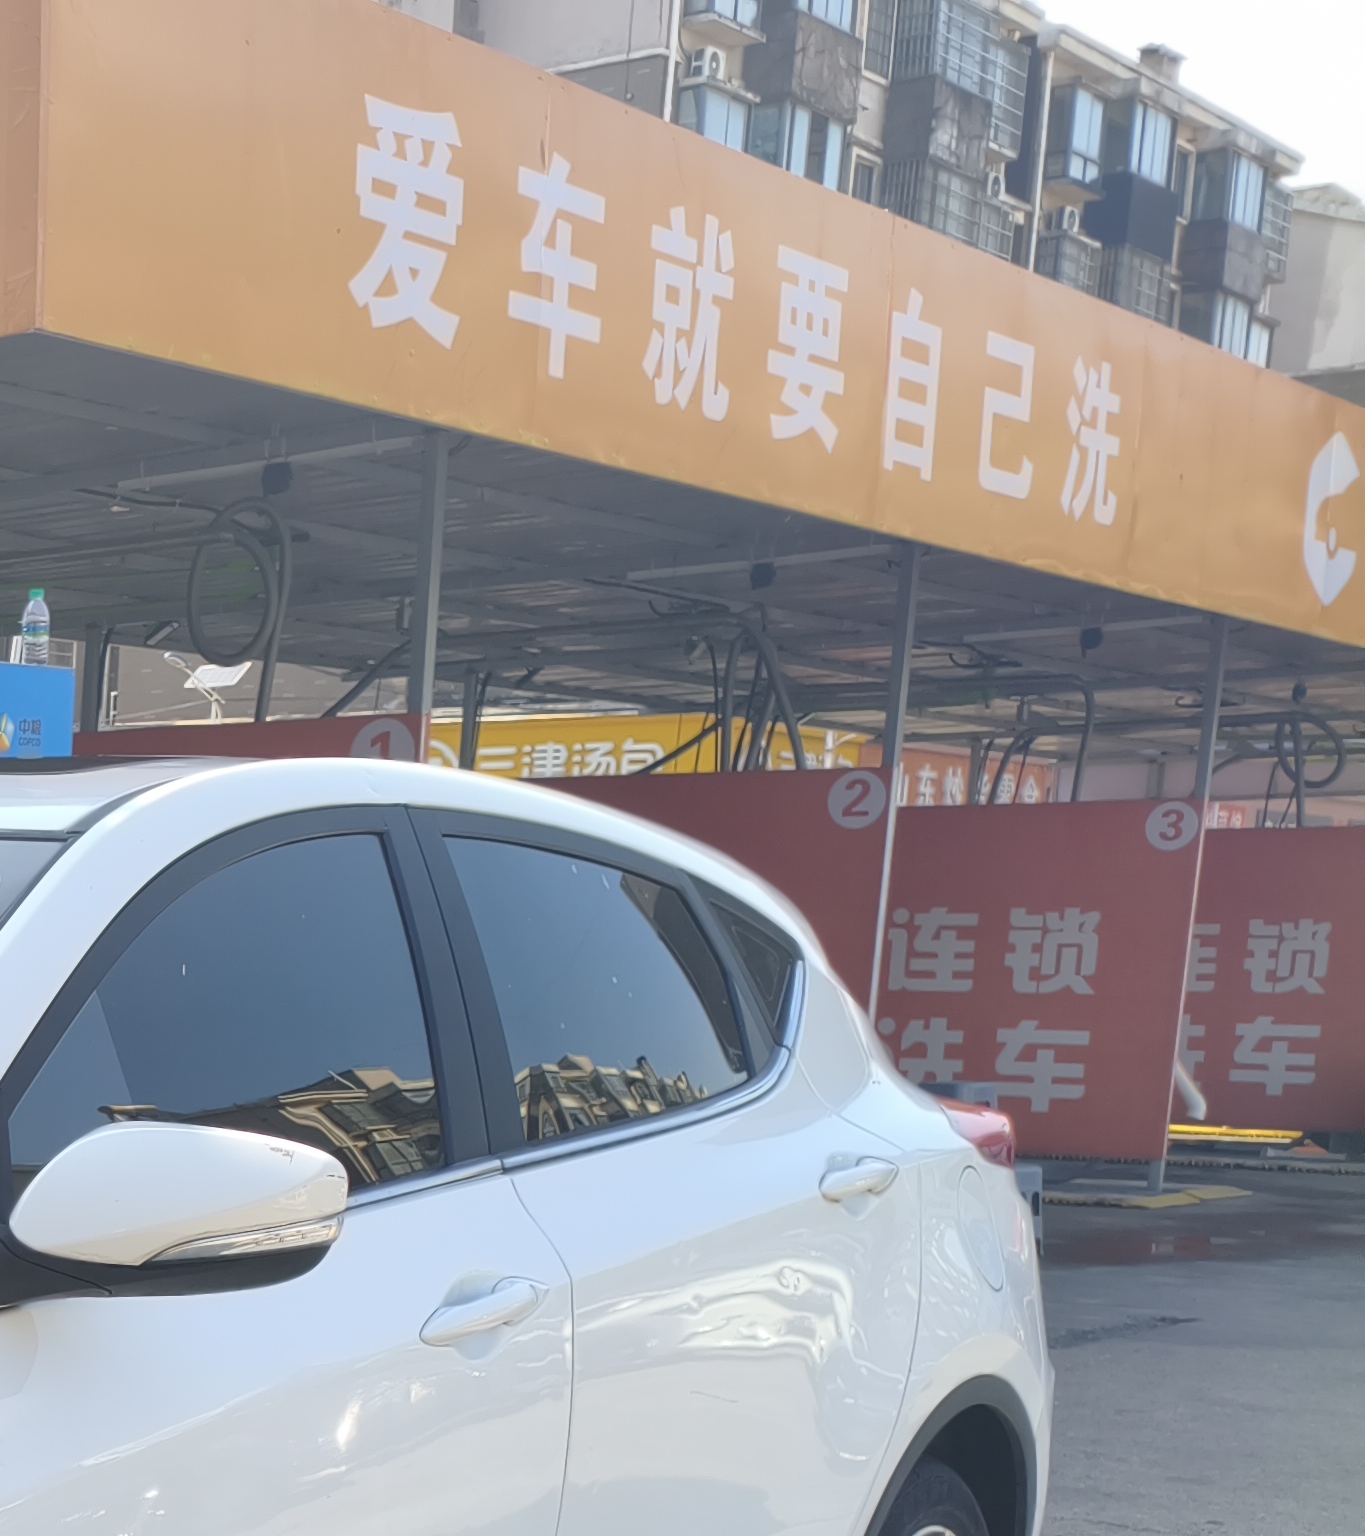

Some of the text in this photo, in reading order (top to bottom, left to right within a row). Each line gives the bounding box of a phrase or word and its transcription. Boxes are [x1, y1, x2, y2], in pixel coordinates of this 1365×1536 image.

[347, 92, 1123, 528] 爱车就要自己洗
[841, 778, 872, 818] 2
[1158, 808, 1185, 842] 3
[887, 906, 1102, 996] 连锁
[877, 1016, 1091, 1114] 洗车
